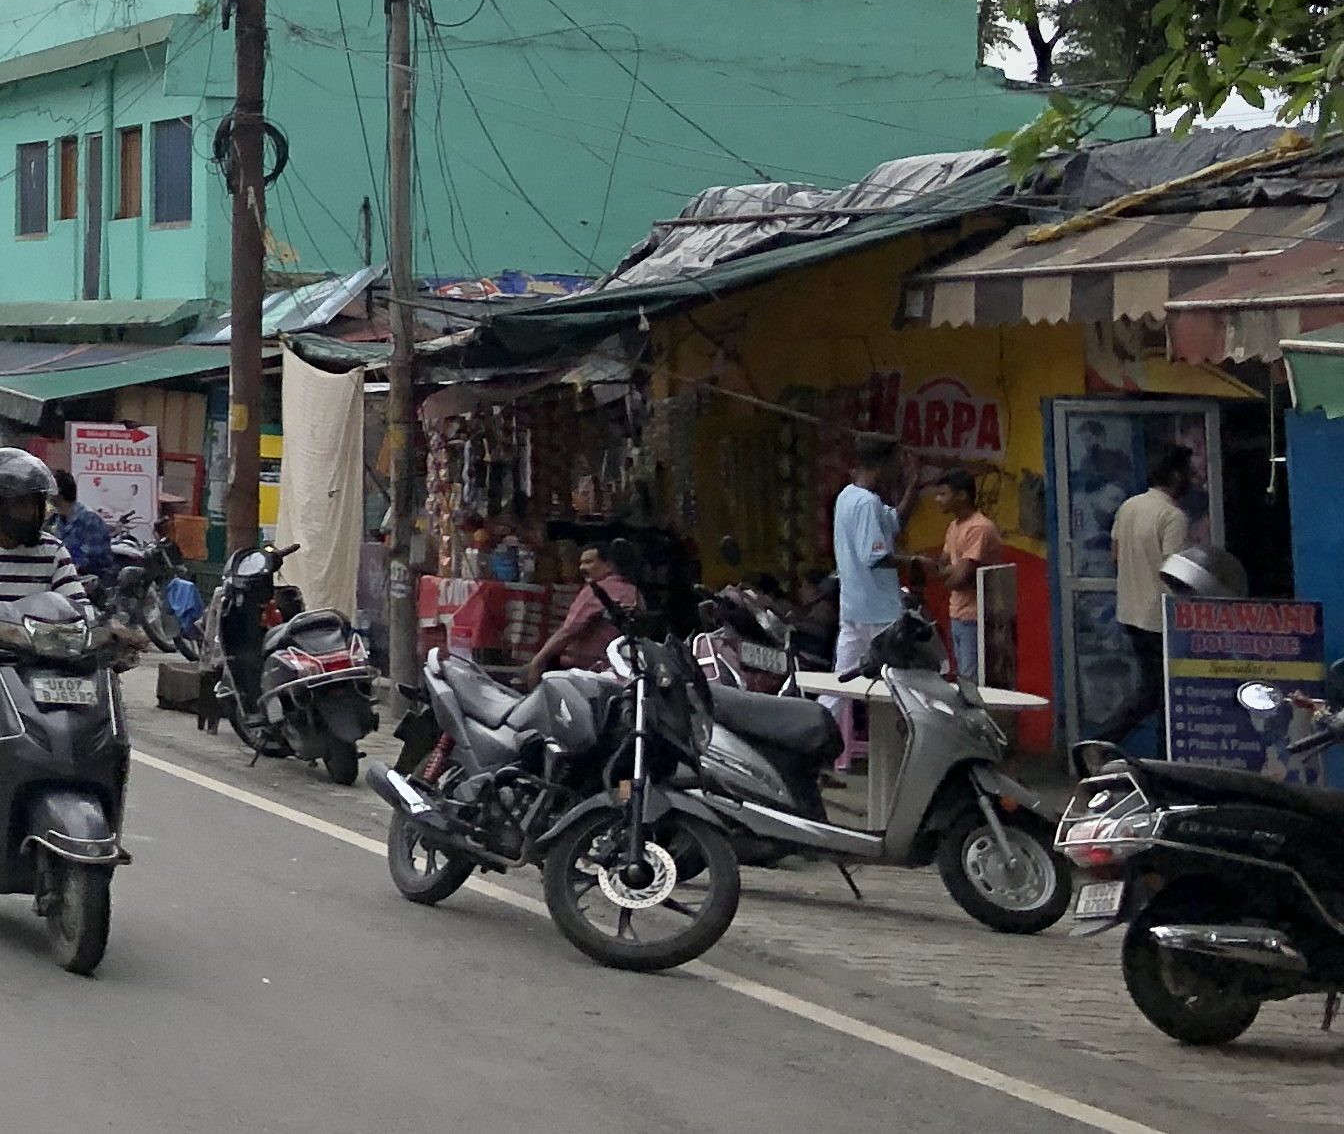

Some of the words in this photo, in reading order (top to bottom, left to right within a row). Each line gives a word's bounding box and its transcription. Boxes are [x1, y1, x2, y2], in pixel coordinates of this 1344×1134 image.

[75, 442, 152, 458] Rajdhani
[85, 460, 144, 473] Jhatka
[1175, 602, 1316, 634] BHAWANI
[1191, 634, 1301, 657] BOUTIQUE
[47, 679, 82, 691] UK07
